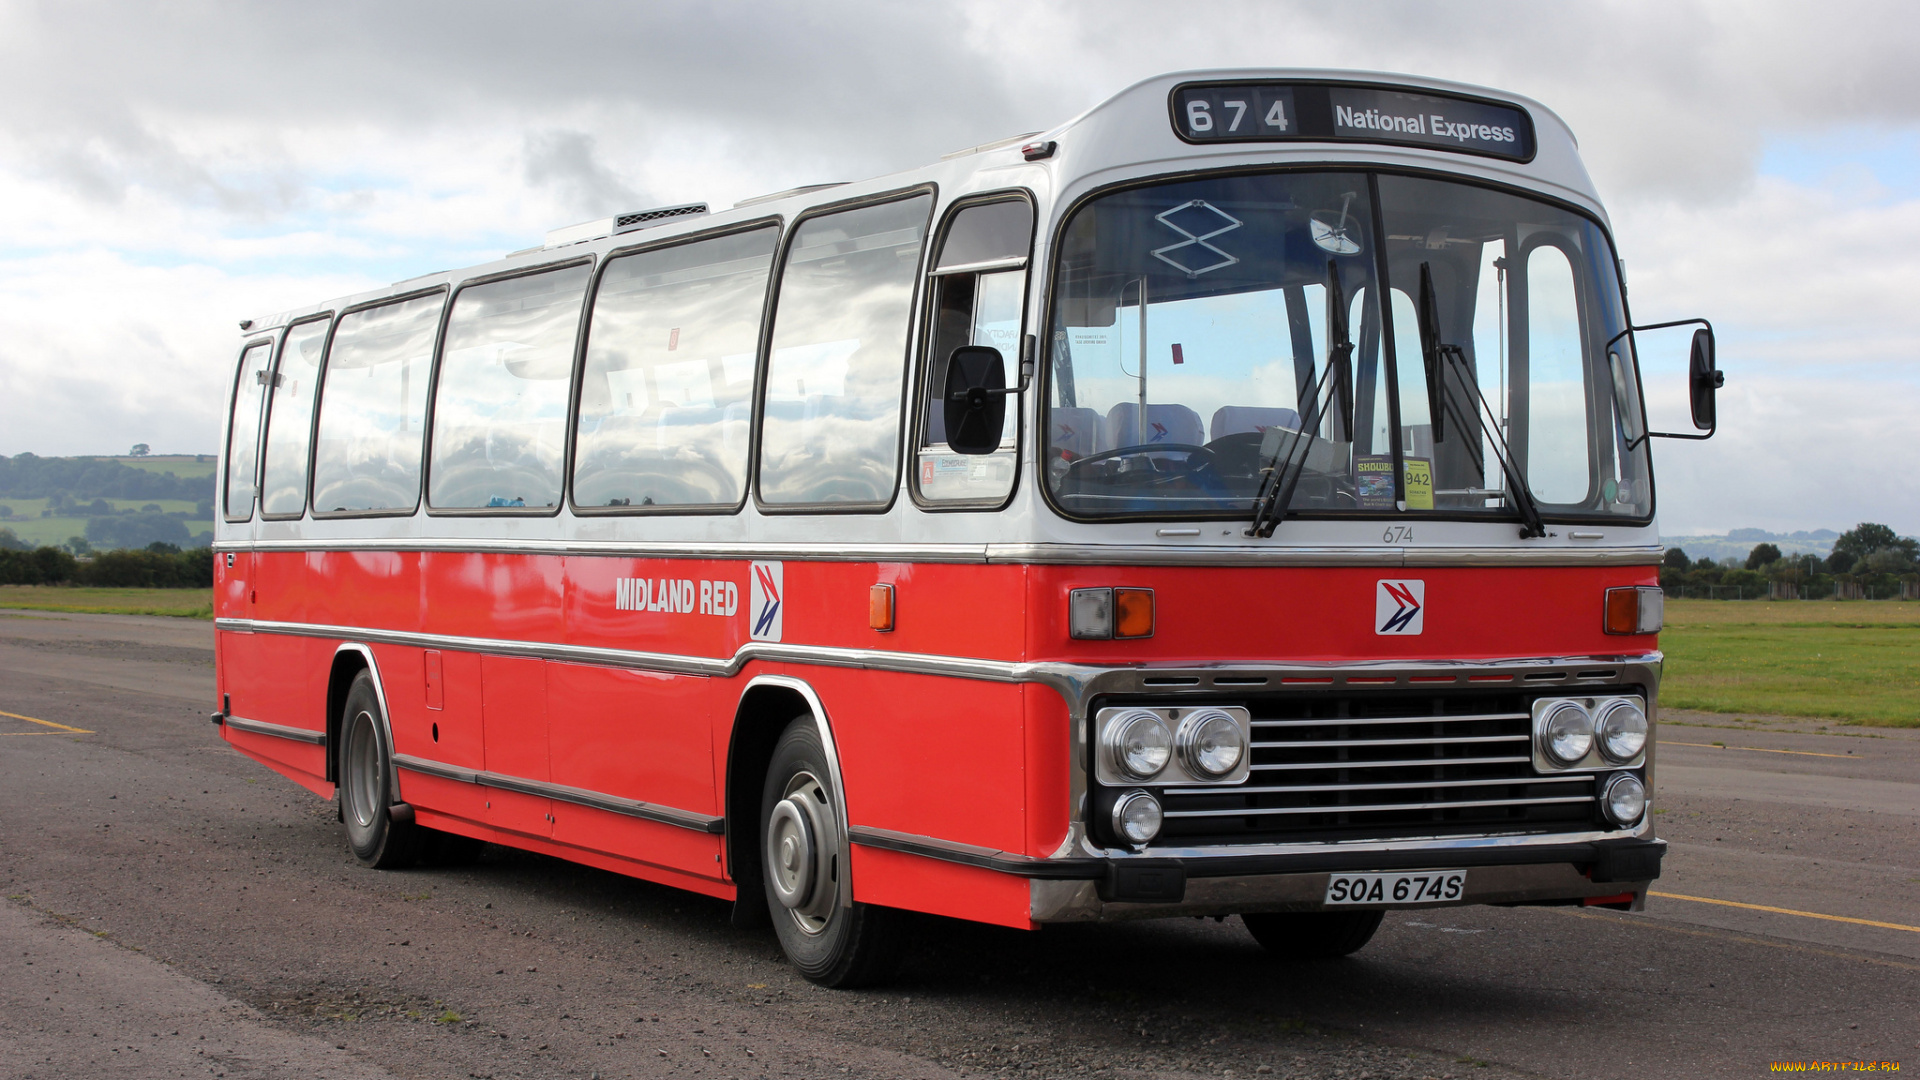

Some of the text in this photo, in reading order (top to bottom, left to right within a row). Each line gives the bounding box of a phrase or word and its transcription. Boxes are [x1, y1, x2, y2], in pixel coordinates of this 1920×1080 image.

[1336, 105, 1516, 143] National Express
[1358, 463, 1394, 472] SHOWBU
[1405, 472, 1430, 486] 942
[1382, 526, 1414, 543] 674
[615, 577, 738, 617] MIDLAND RED
[1331, 876, 1462, 901] SOA 674S
